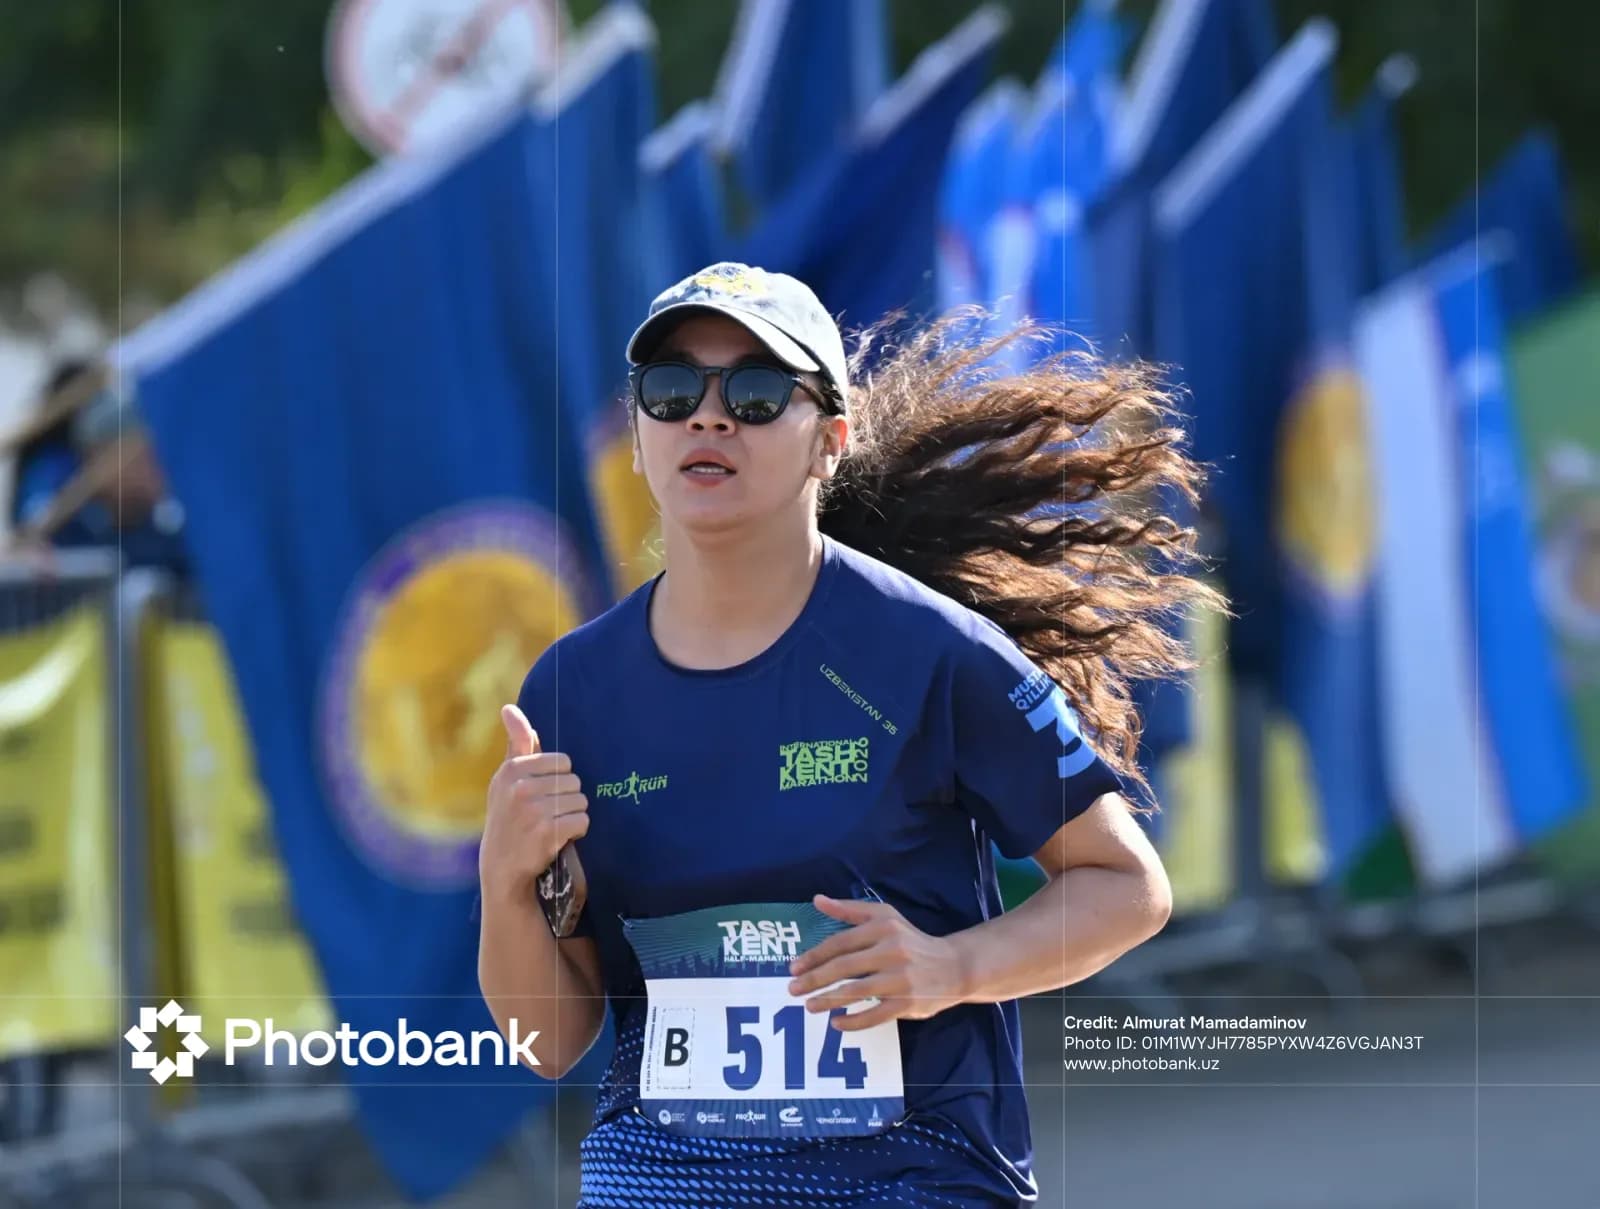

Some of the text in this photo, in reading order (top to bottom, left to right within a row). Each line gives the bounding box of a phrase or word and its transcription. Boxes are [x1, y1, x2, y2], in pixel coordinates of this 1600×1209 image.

[820, 664, 898, 735] UZBEKISTAN 35
[780, 742, 856, 767] TASH
[780, 761, 849, 784] KENT
[780, 773, 857, 791] MARATHON
[597, 775, 668, 798] PRO RUN
[717, 920, 801, 942] TASH
[723, 936, 799, 955] KENT
[724, 954, 799, 962] HALF-MARATHO
[664, 1028, 689, 1067] B
[722, 1005, 868, 1091] 514
